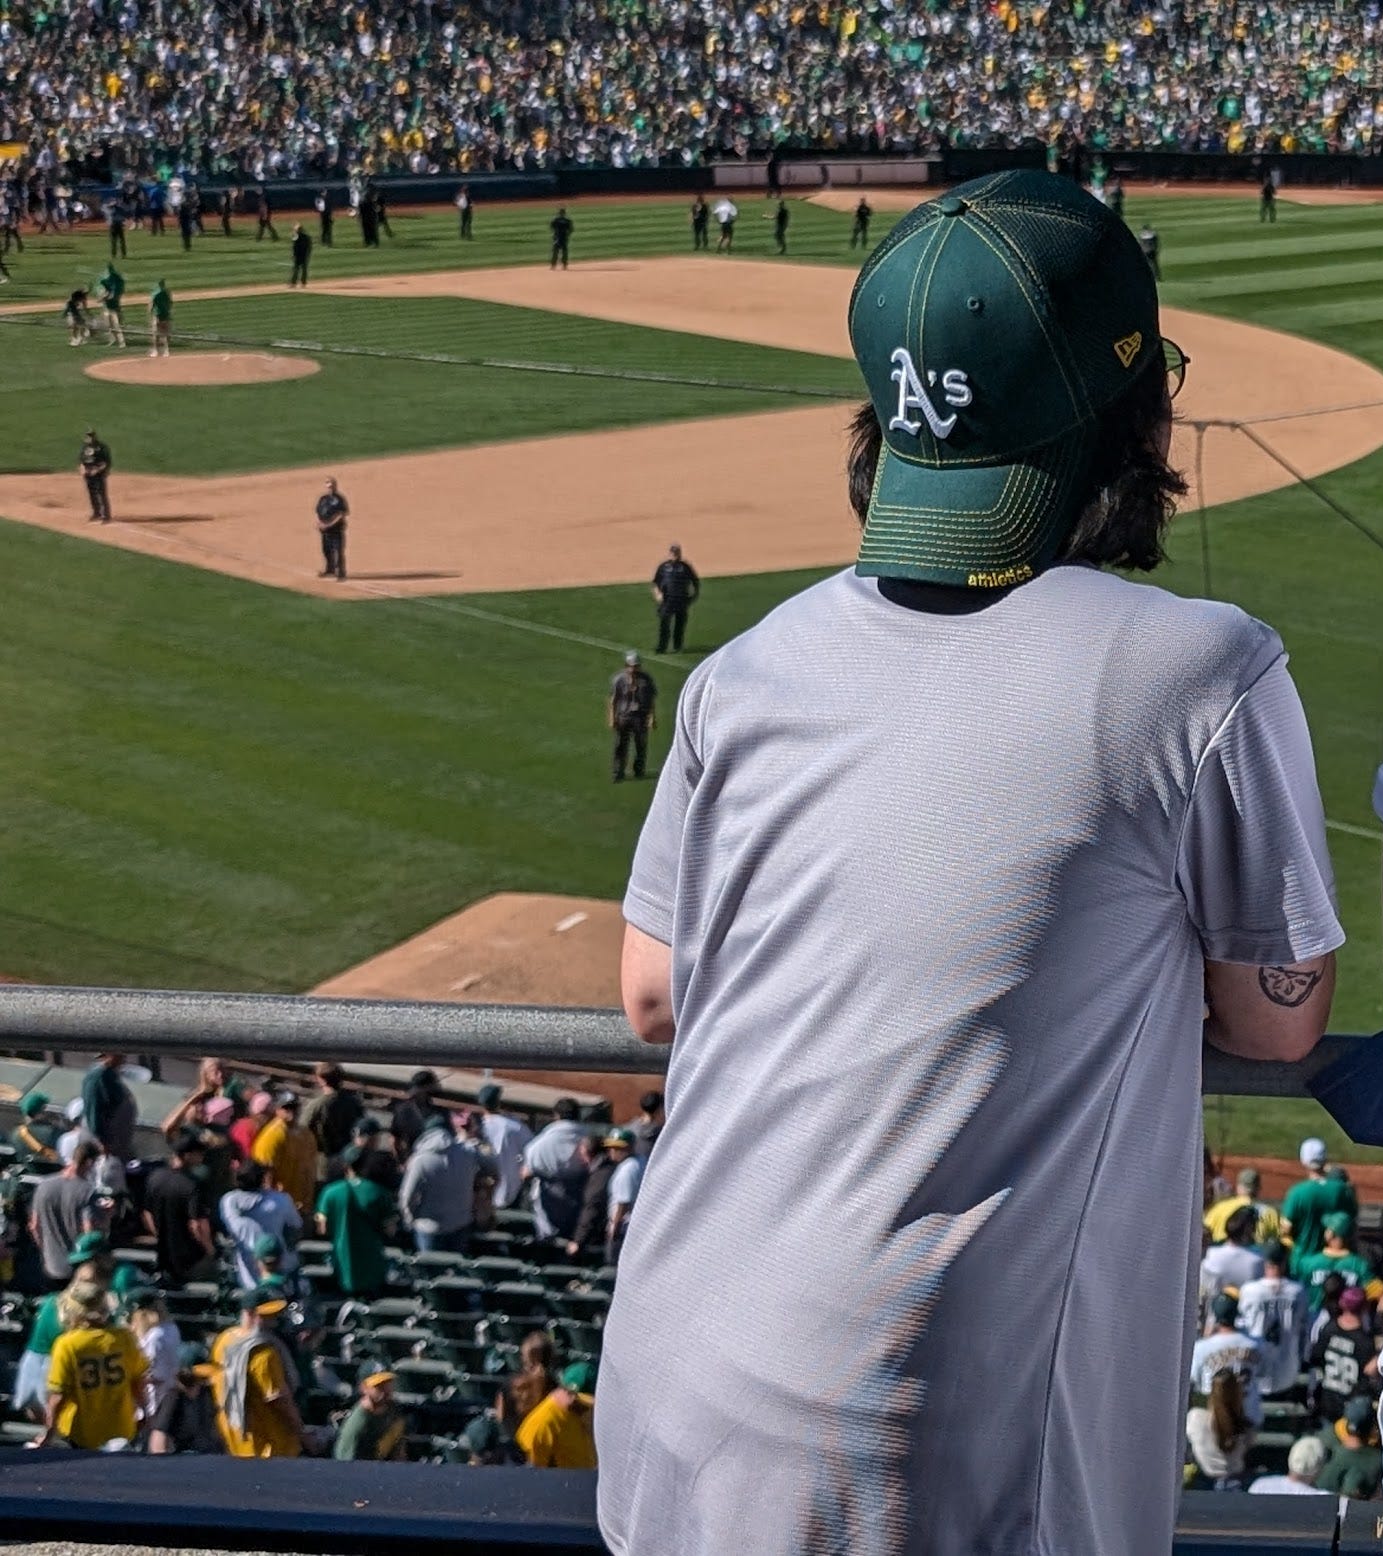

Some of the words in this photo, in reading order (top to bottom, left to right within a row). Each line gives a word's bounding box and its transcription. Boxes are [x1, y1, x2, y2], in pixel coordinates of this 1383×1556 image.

[888, 347, 973, 440] A's
[968, 565, 1033, 588] athletics
[78, 1352, 126, 1390] 35
